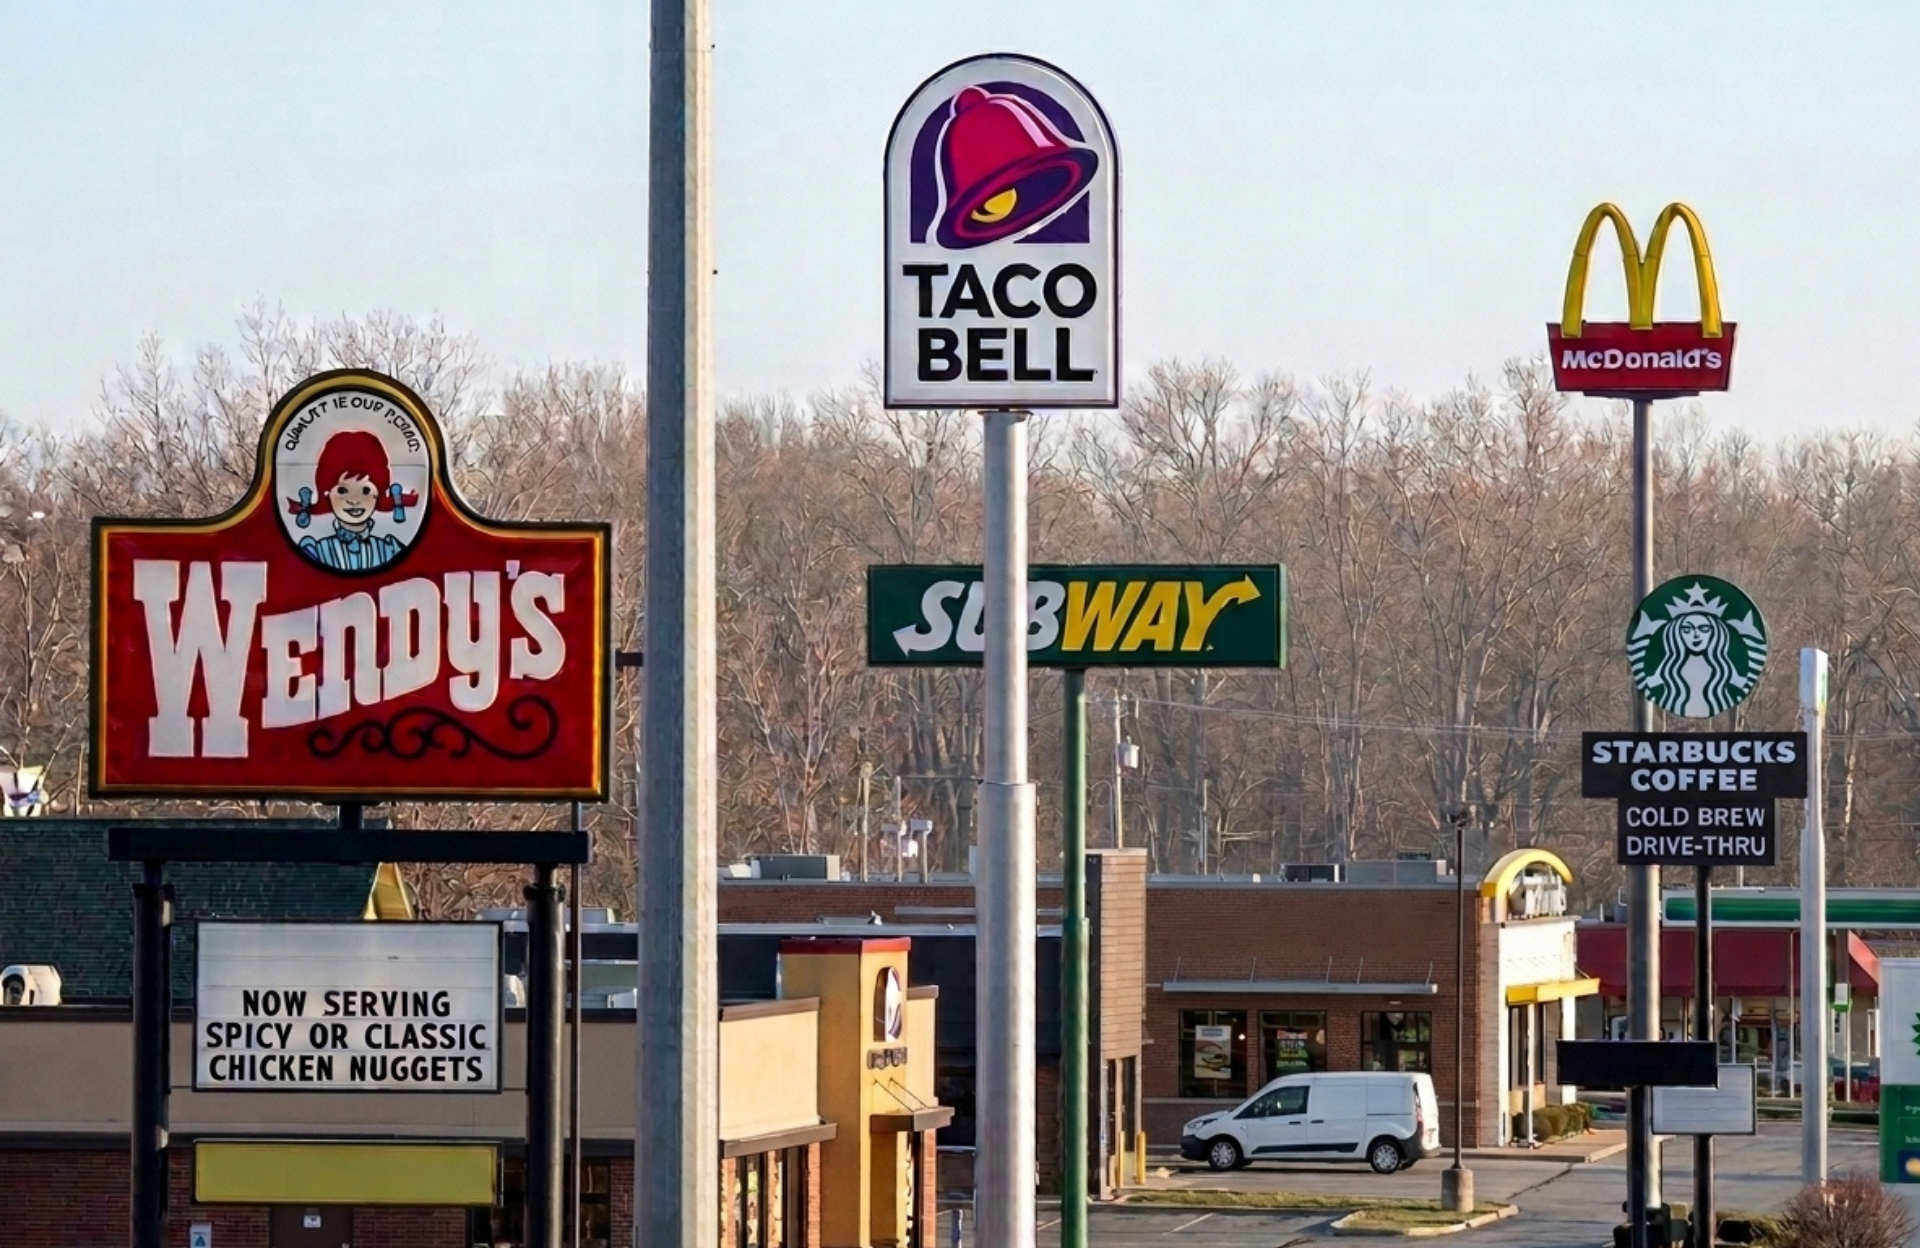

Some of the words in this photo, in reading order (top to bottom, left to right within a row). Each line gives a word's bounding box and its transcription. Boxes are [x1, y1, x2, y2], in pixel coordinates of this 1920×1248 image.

[903, 263, 1097, 318] TACO
[918, 328, 1094, 381] BELL
[1561, 349, 1722, 369] McDonald's
[133, 559, 566, 758] Wendy's
[1592, 741, 1796, 764] STARBUCKS
[1630, 769, 1758, 791] COFFEE
[1626, 807, 1689, 827] COLD
[1698, 807, 1765, 827] BREW
[1626, 836, 1766, 856] DRIVE-THRU
[242, 990, 307, 1017] NOW
[323, 990, 451, 1017] SERVING
[206, 1022, 293, 1049] SPICY
[309, 1023, 349, 1049] OR
[364, 1024, 487, 1050] CLASSIC
[209, 1055, 334, 1082] CHICKEN
[350, 1056, 483, 1082] NUGGETS
